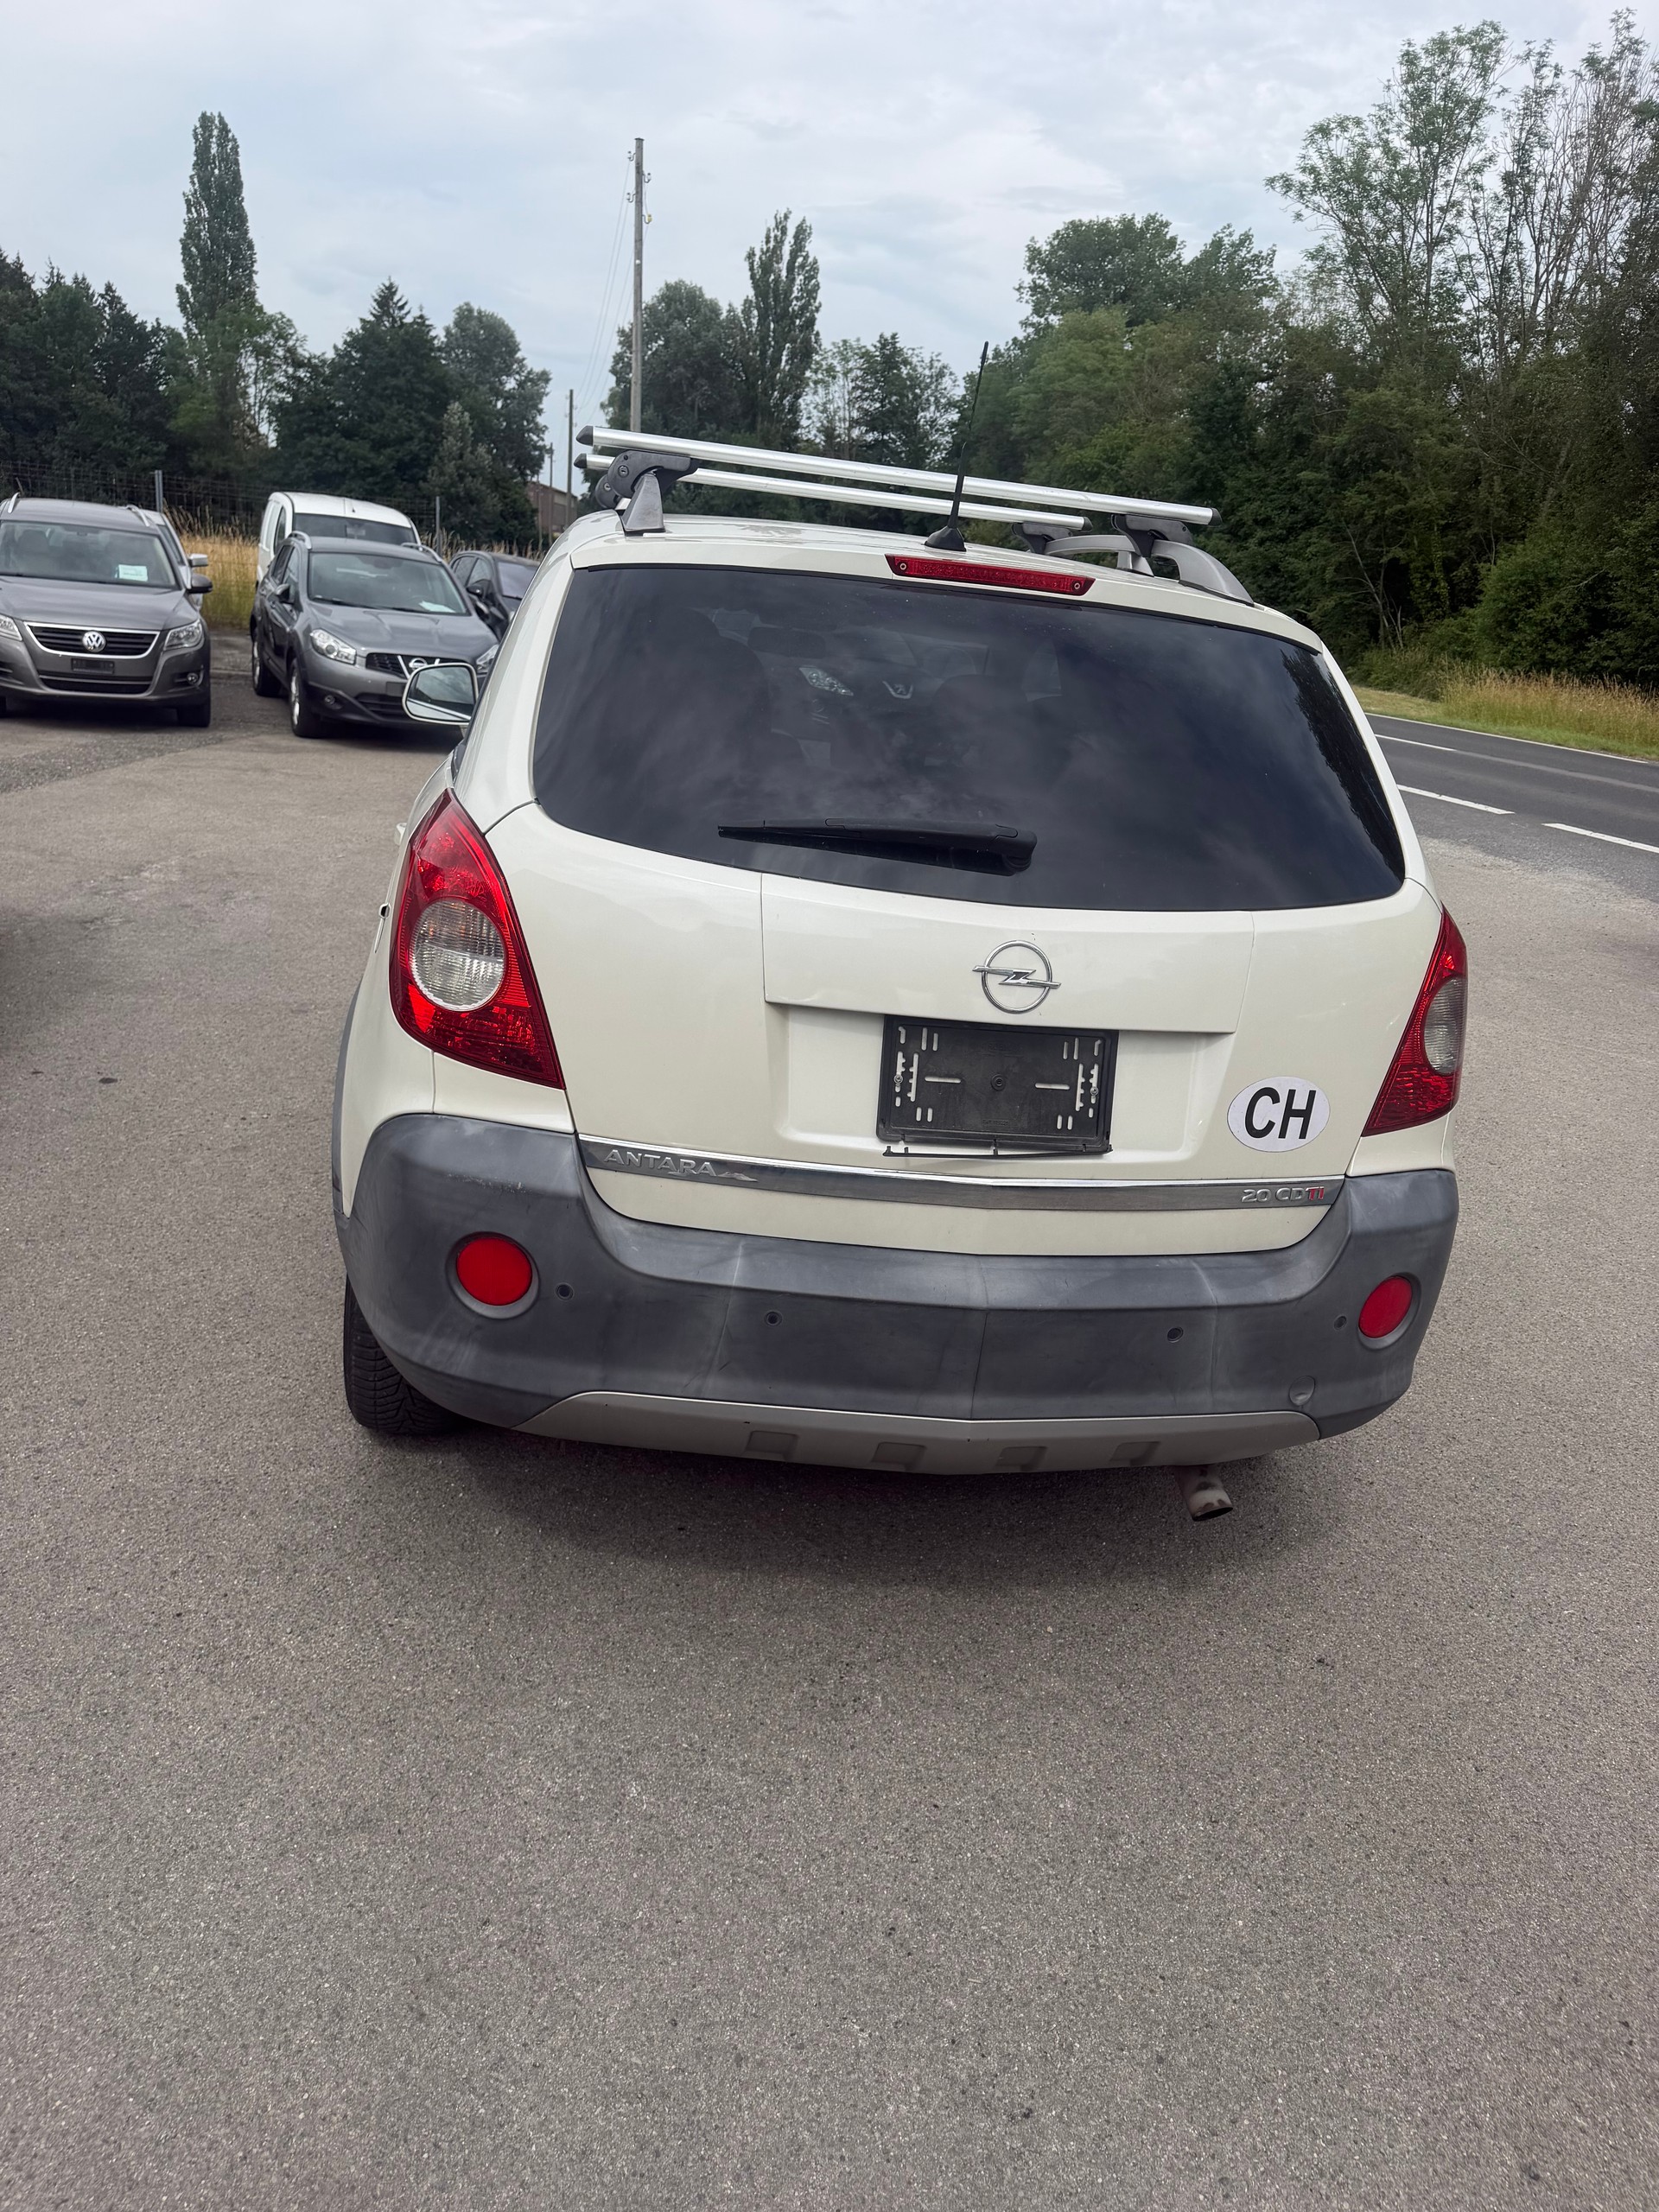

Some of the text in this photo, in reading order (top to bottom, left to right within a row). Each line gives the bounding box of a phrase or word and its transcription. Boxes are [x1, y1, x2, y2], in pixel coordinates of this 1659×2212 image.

[84, 632, 105, 651] VW
[1244, 1086, 1317, 1140] CH
[604, 1148, 717, 1177] ANTARA
